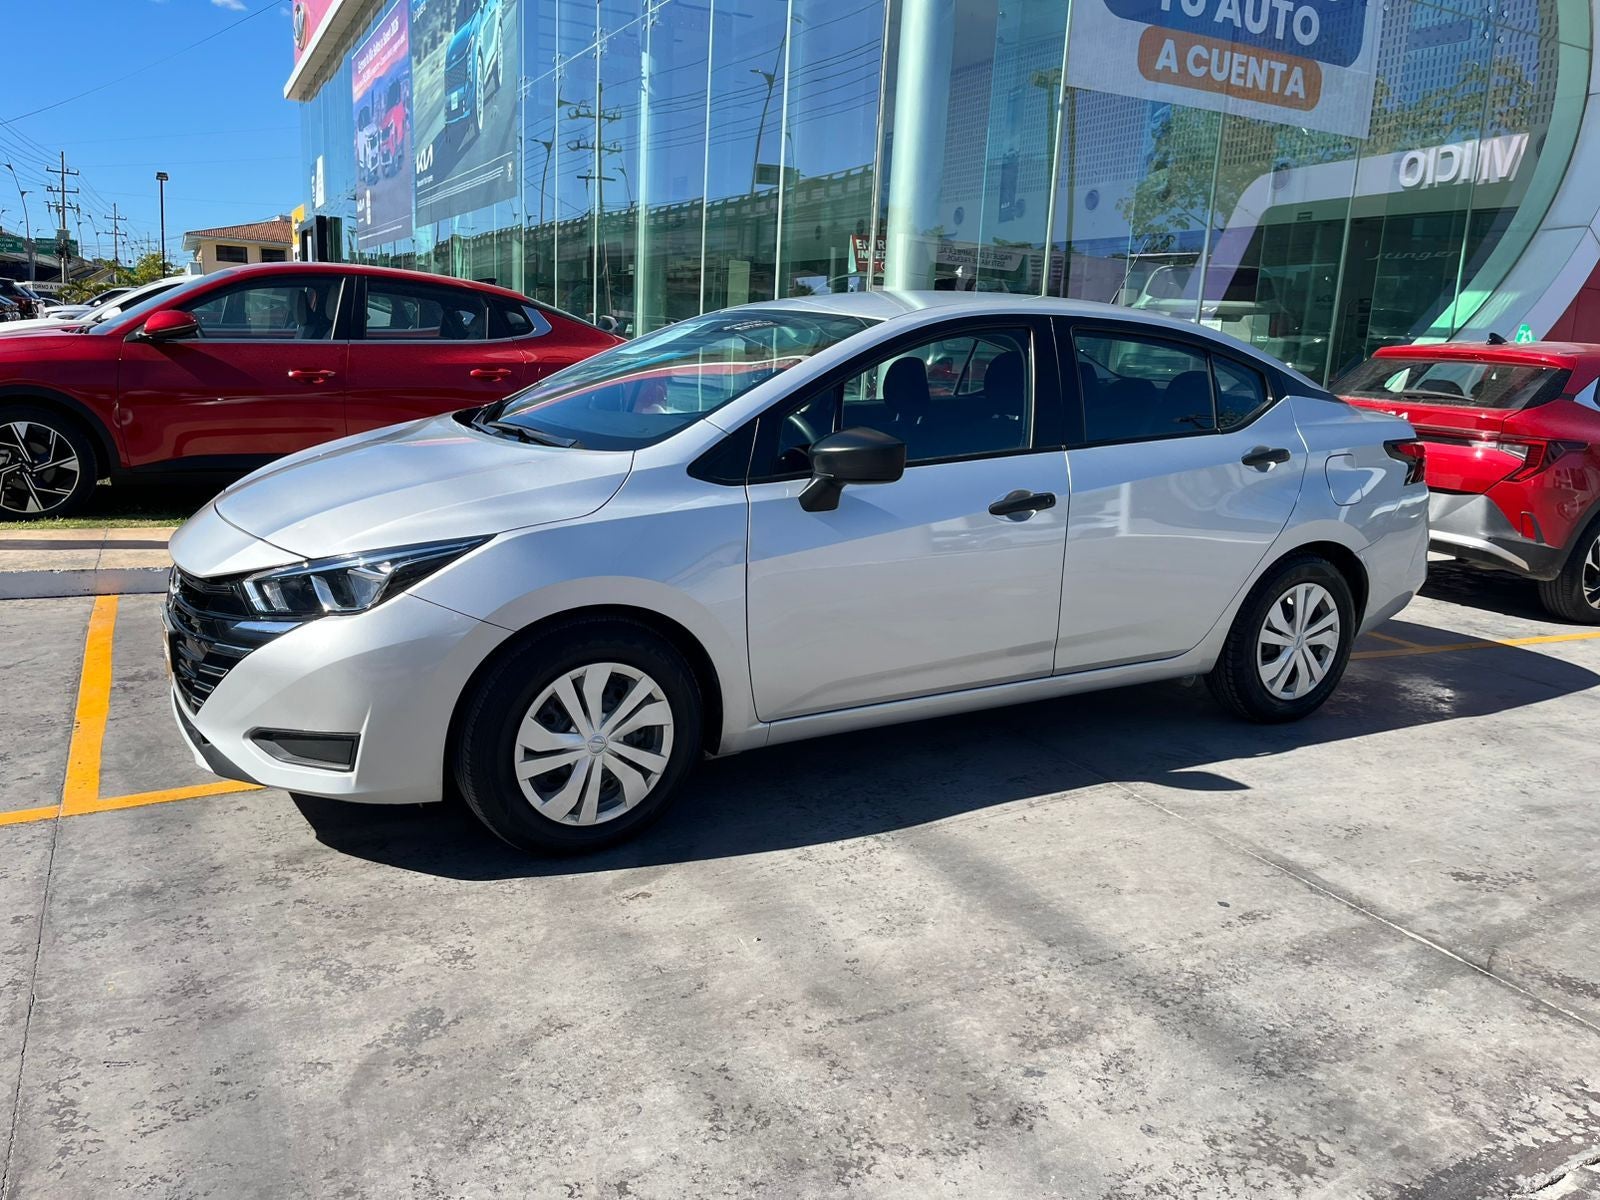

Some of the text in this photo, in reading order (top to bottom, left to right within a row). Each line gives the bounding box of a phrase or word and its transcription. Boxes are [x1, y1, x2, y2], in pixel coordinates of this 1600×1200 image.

[1214, 0, 1320, 46] AUTO
[1155, 39, 1306, 99] A CUENTA
[1520, 330, 1532, 344] 21
